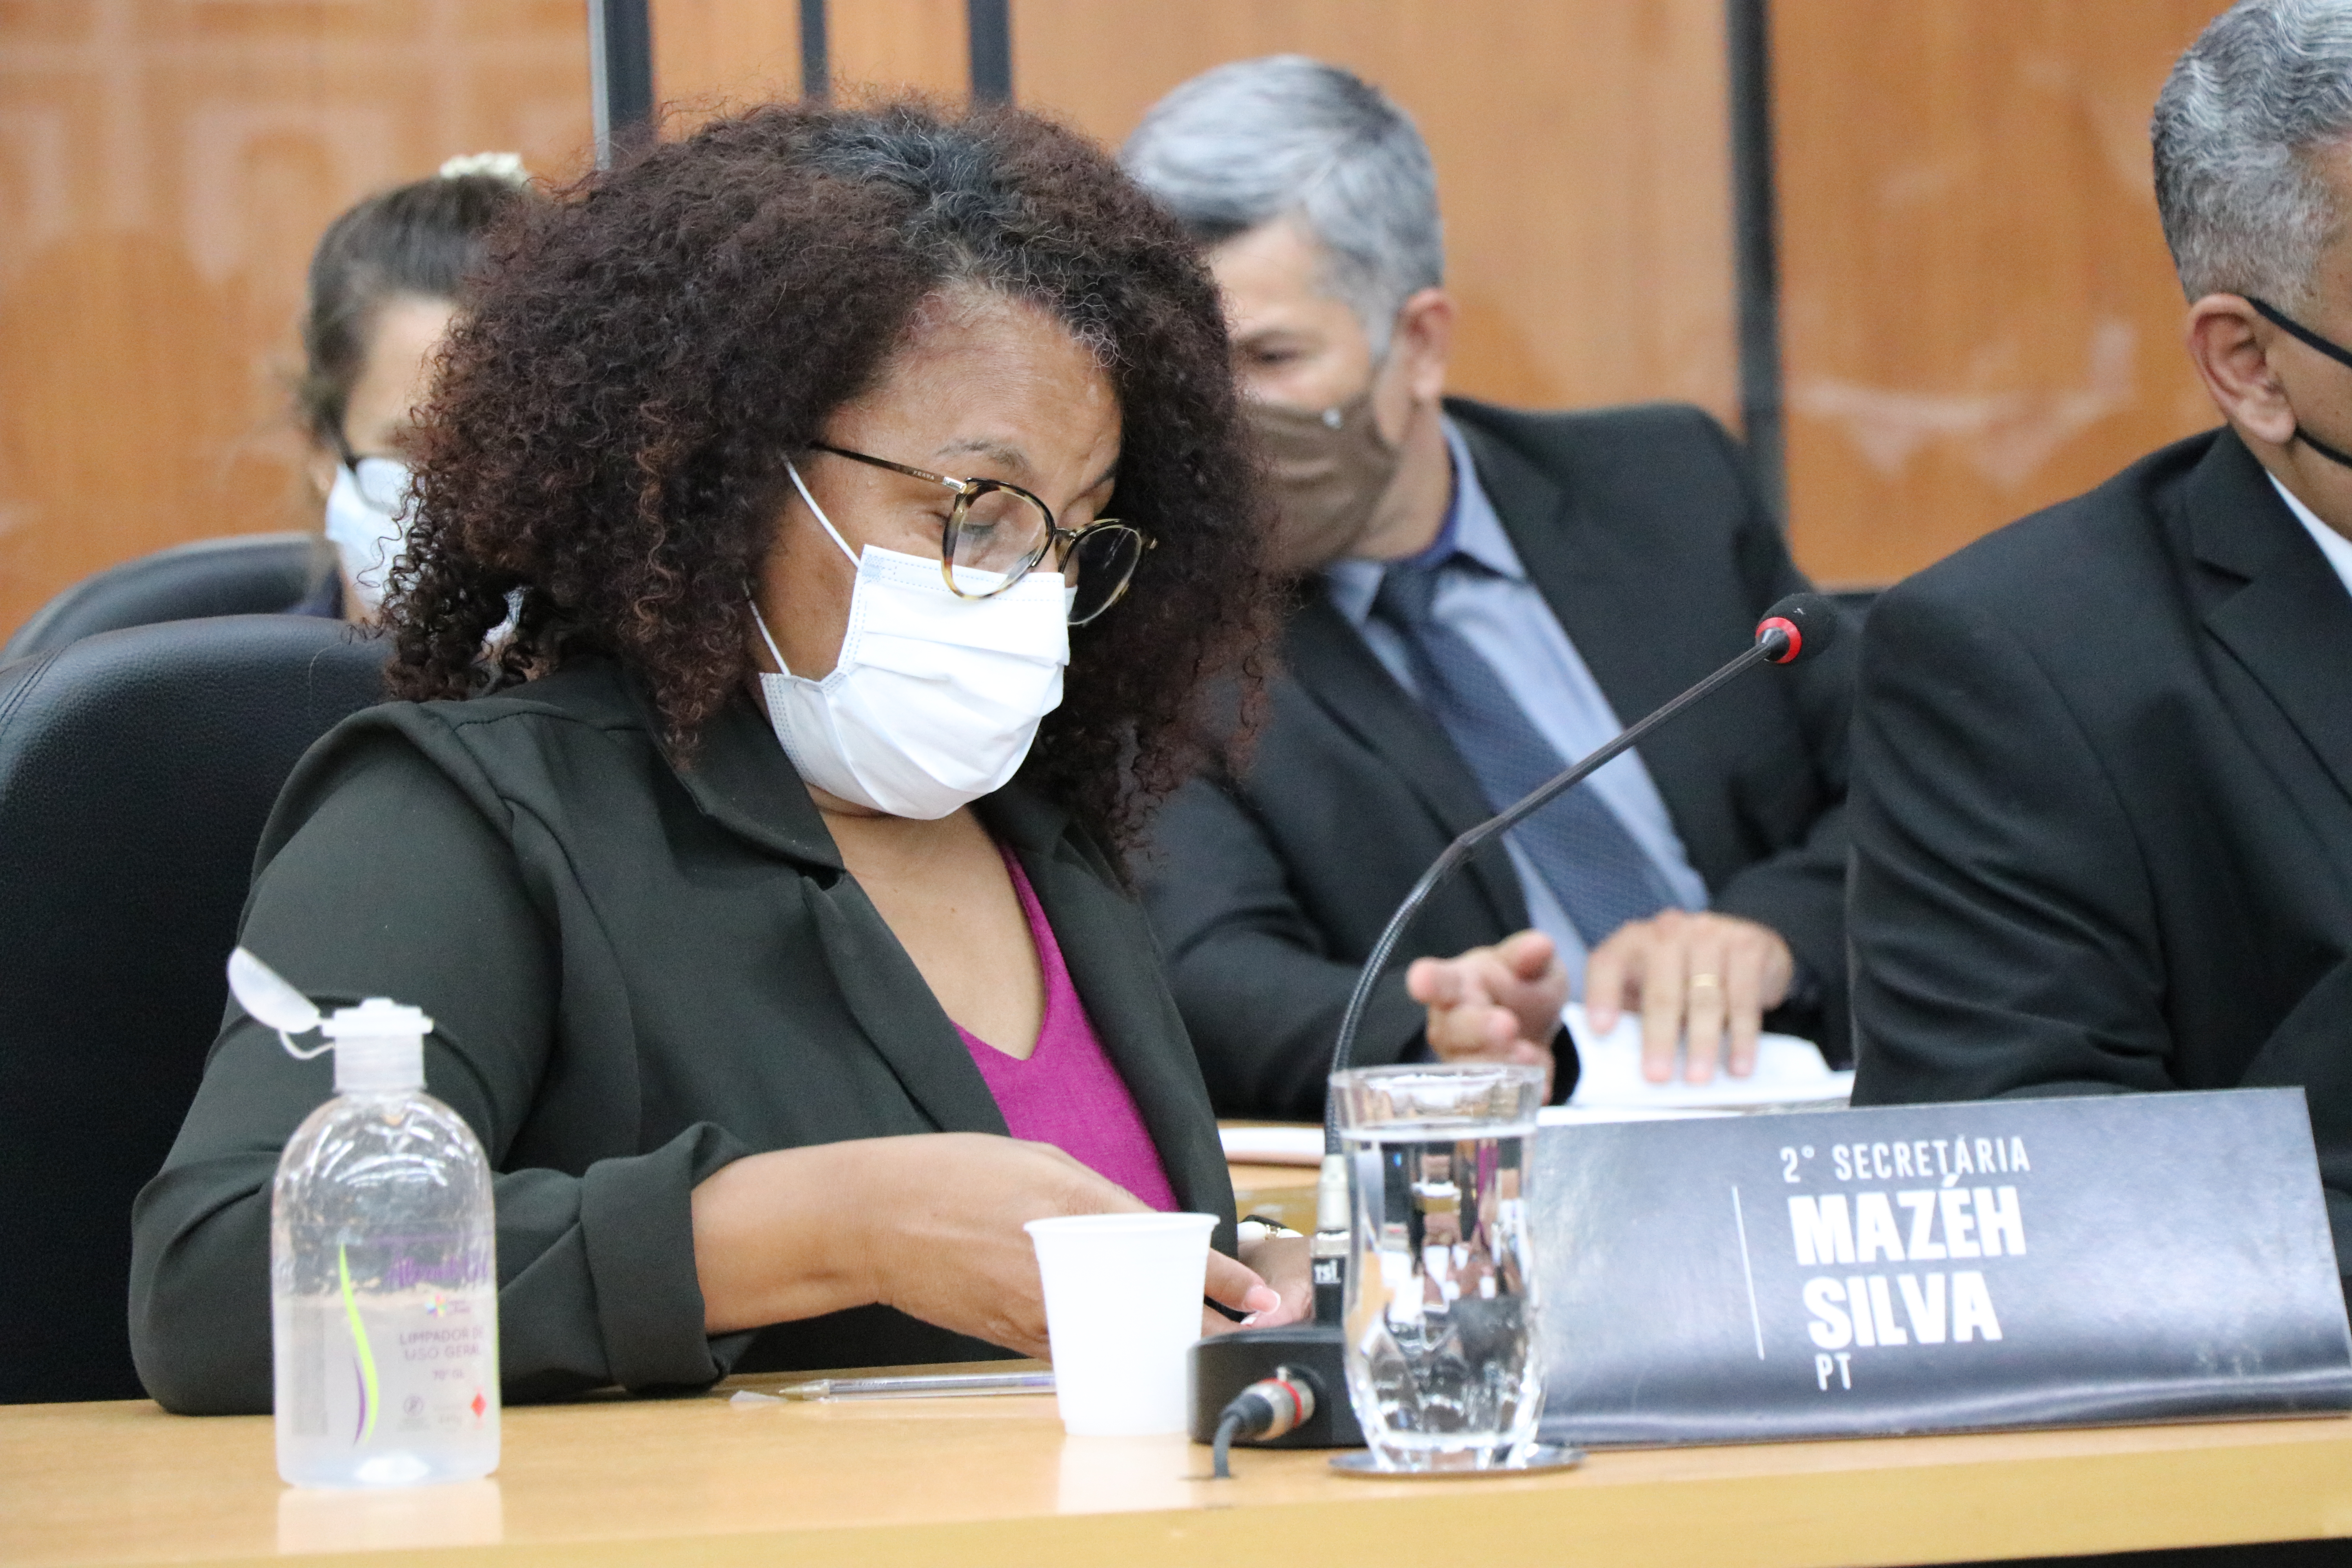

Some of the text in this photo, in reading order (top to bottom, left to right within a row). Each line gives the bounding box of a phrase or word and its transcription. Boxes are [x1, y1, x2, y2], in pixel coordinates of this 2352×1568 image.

[913, 470, 935, 480] PRADA
[1832, 1134, 2031, 1181] SECRETÁRIA
[1787, 1174, 2027, 1266] MAZÉH
[1803, 1270, 2003, 1350] SILVA
[399, 1327, 469, 1345] LIMPADOR
[405, 1347, 439, 1361] USO
[1815, 1352, 1852, 1391] PT
